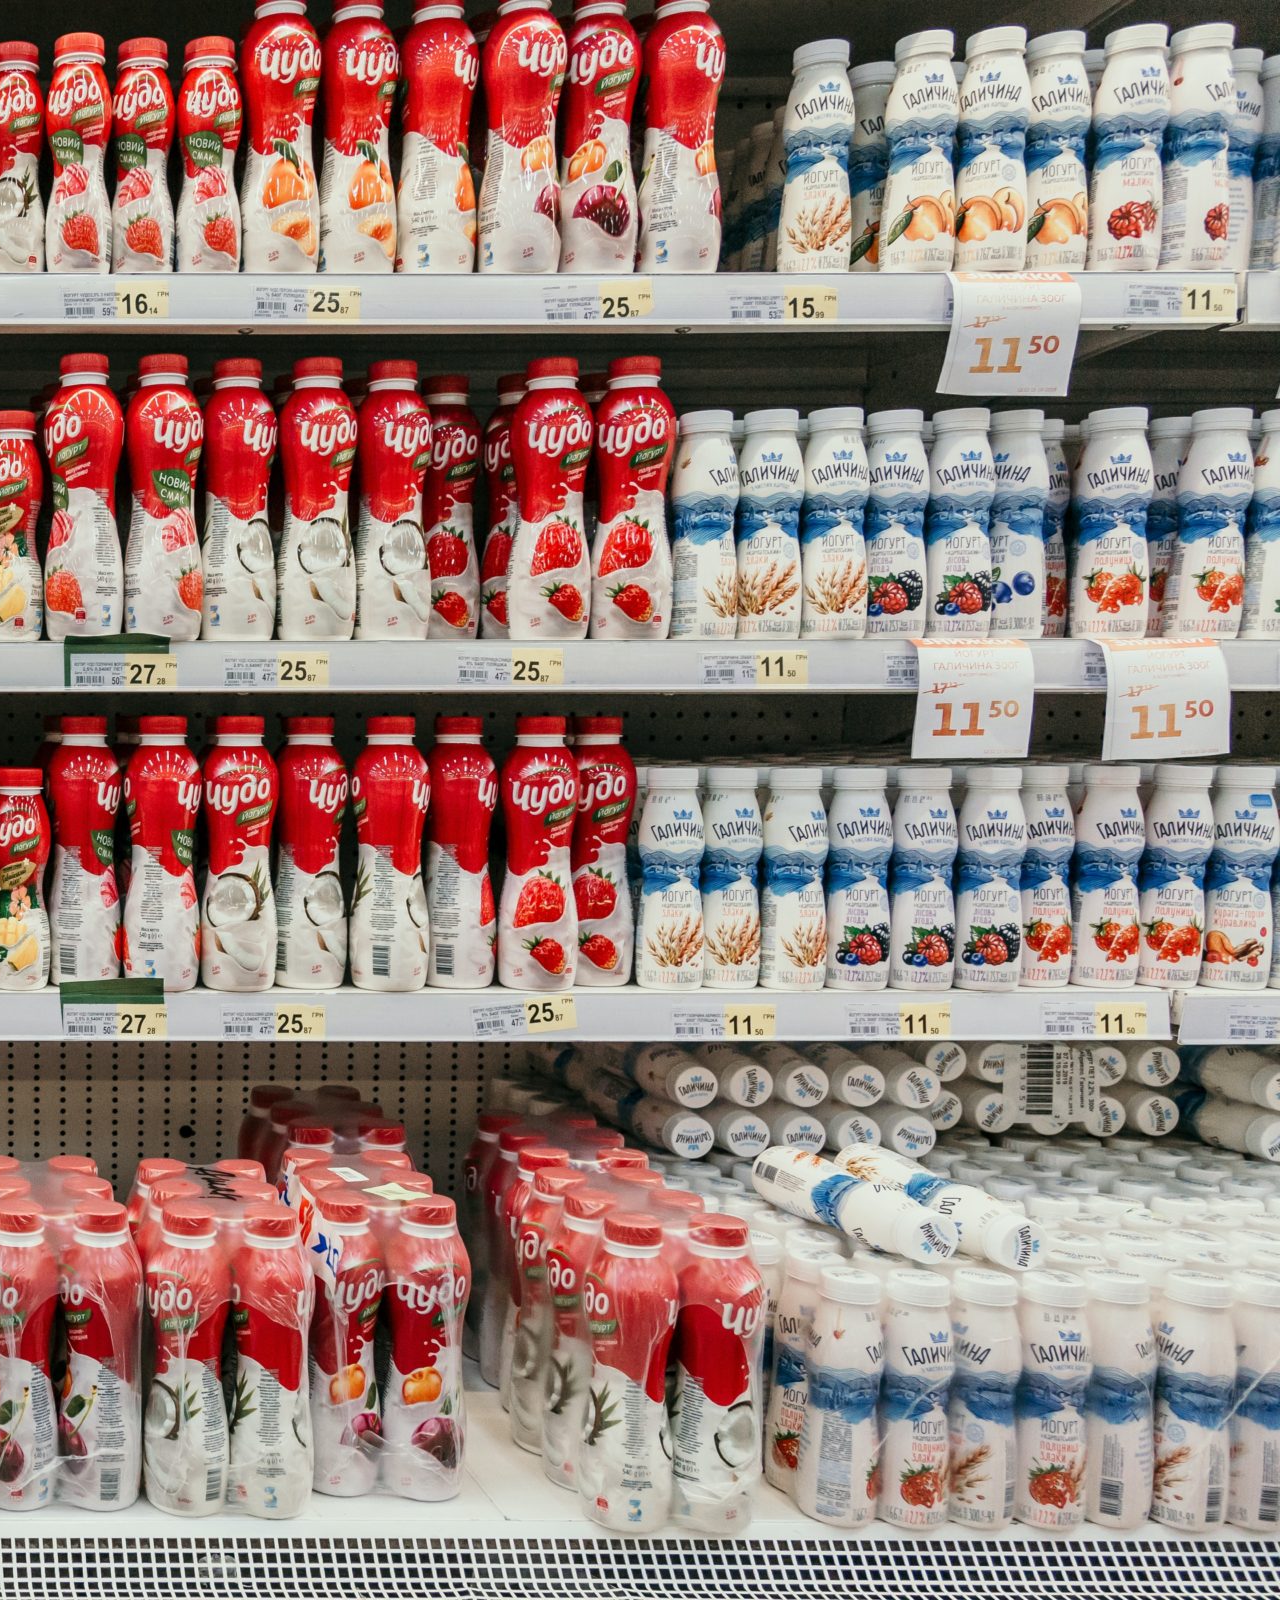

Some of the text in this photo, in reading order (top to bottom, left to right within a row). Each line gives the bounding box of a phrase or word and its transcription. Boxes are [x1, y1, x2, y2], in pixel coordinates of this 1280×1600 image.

[960, 84, 1022, 112] ГАЛИЧИНА
[121, 294, 148, 315] 16
[312, 291, 340, 314] 25
[340, 306, 349, 314] 87
[602, 297, 630, 318] 25
[788, 297, 815, 318] 15
[1187, 290, 1211, 310] 11
[968, 335, 1060, 374] 11 50
[44, 413, 81, 458] удо
[432, 429, 477, 470] удо
[159, 472, 190, 494] НОВИЙ
[1087, 466, 1150, 489] ГАЛИЧИНА
[160, 490, 185, 504] СМАК
[746, 536, 782, 549] ЙОГУРТ
[1096, 536, 1132, 549] ЙОГУРТ
[129, 665, 156, 684] 27
[157, 677, 166, 685] 28
[281, 661, 307, 682] 25
[513, 661, 540, 681] 25
[760, 657, 784, 677] 11
[932, 700, 1019, 737] 11 50
[1130, 700, 1214, 740] 11 50
[580, 771, 626, 812] удо
[966, 823, 1024, 840] ГАЛИЧИНА
[973, 890, 1008, 901] ЙОГУРТ
[528, 1002, 554, 1023] 25
[121, 1014, 147, 1035] 27
[277, 1014, 303, 1034] 25
[728, 1015, 753, 1034] 11
[904, 1013, 928, 1034] 11
[1100, 1013, 1124, 1034] 11
[678, 1081, 714, 1097] ГАЛИЧИНА
[730, 1131, 767, 1144] ГАЛИЧИНА
[149, 1280, 192, 1317] удо
